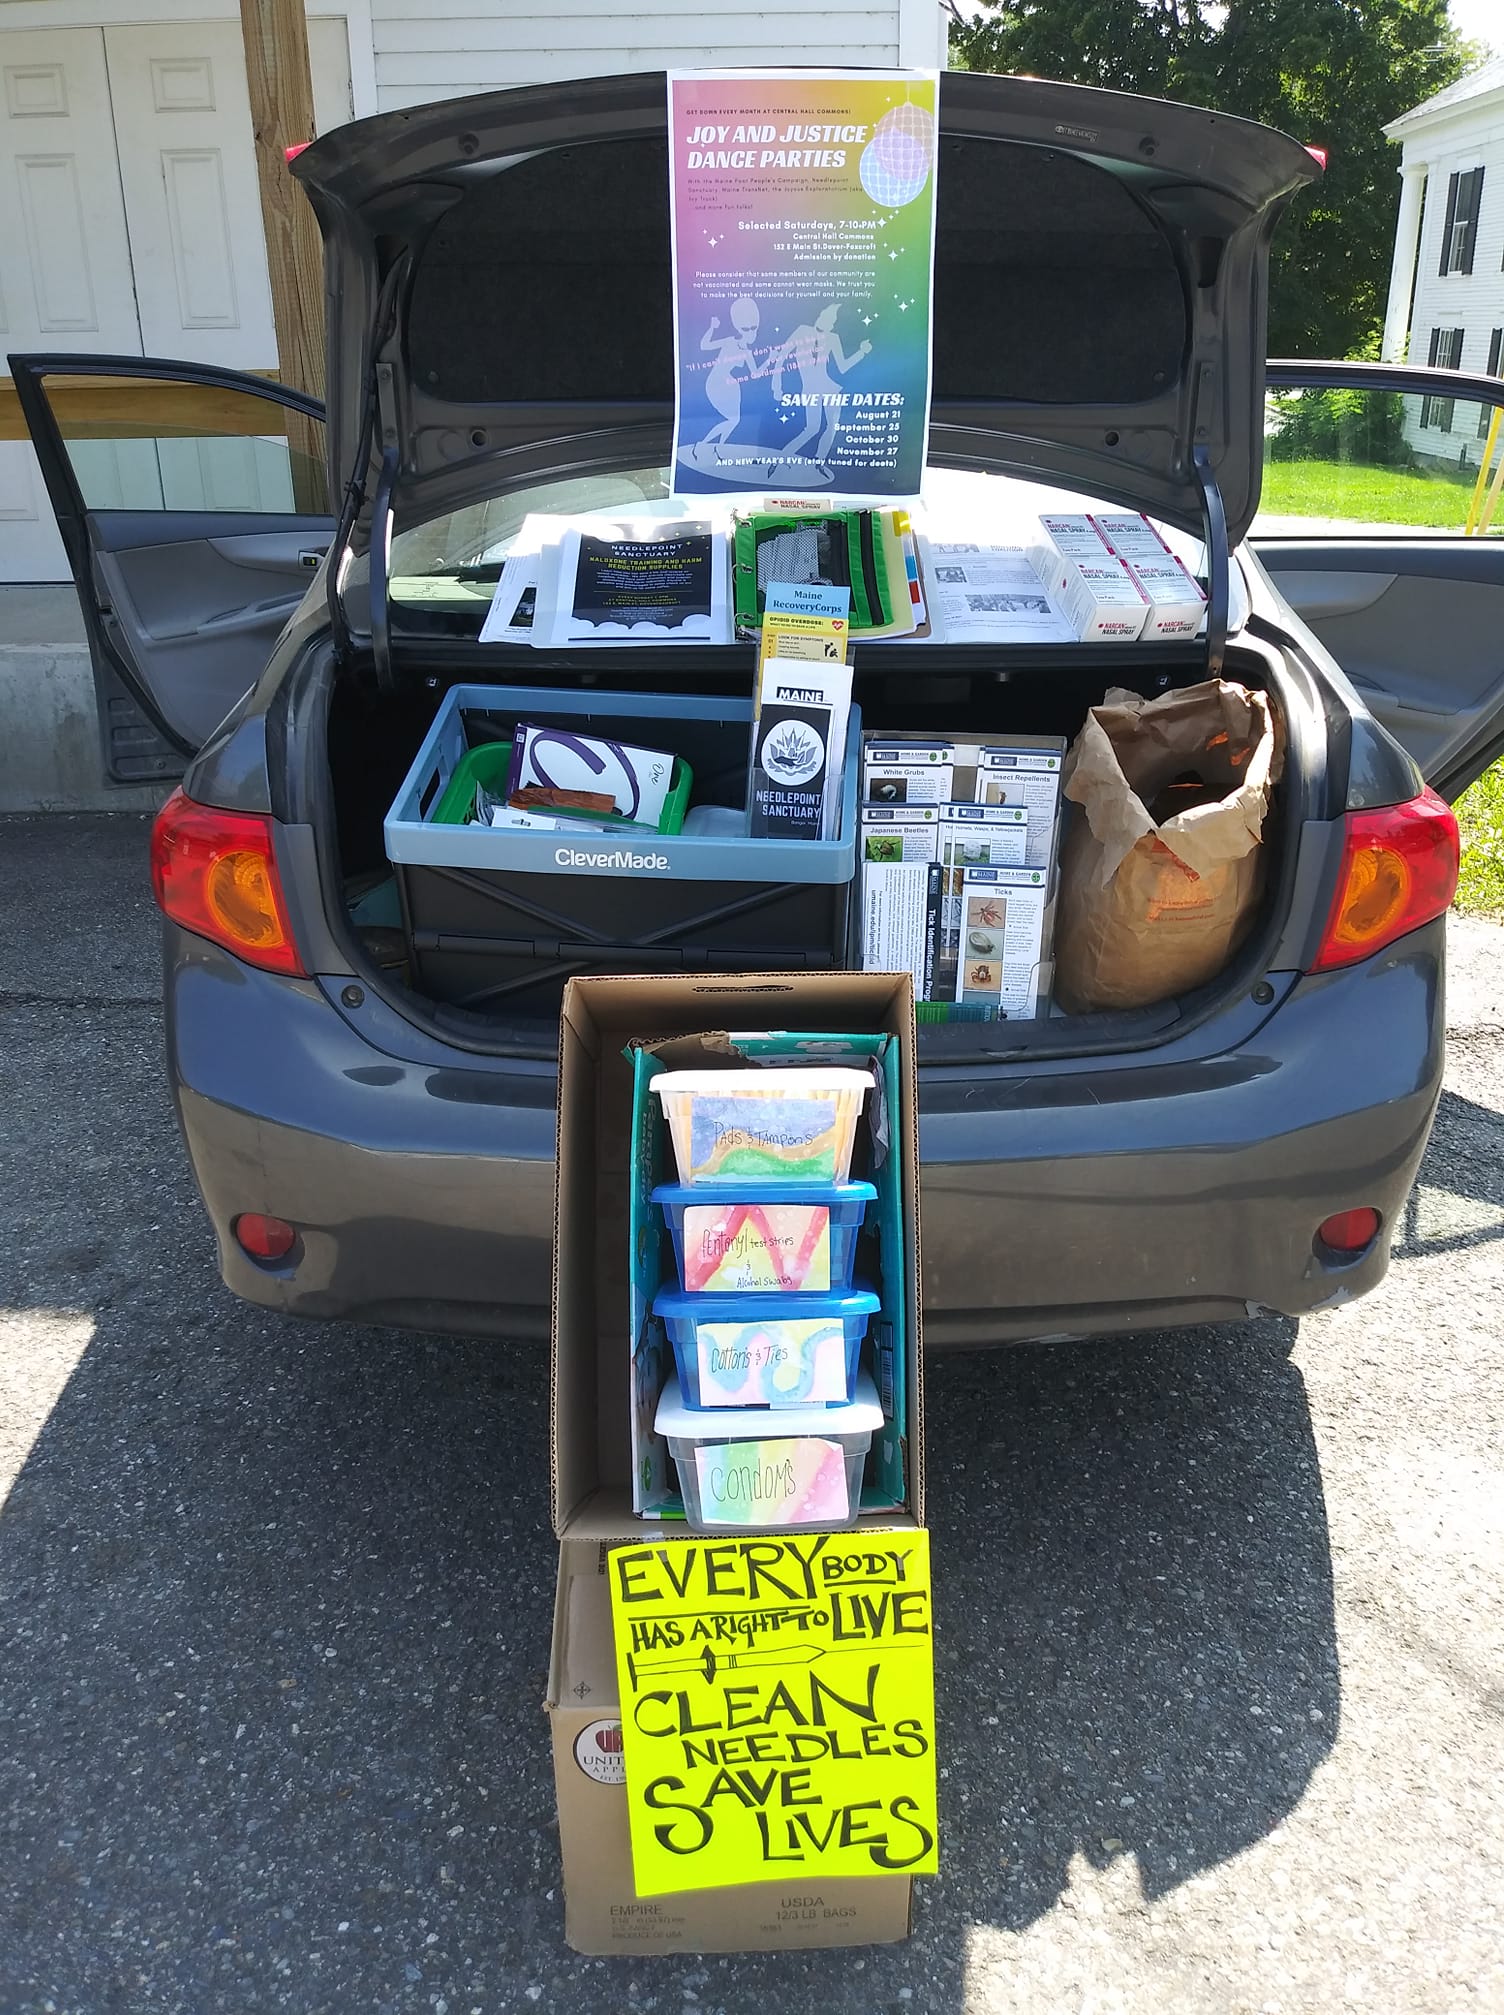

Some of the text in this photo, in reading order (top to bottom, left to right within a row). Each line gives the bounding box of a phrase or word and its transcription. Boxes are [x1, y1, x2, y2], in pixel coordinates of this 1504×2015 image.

[686, 125, 868, 144] JOY AND JUSTICE
[688, 150, 846, 169] DANCE PARTIES
[738, 221, 781, 230] Selected
[784, 221, 836, 231] Saturdays,
[781, 393, 905, 407] SAVE THE DATES:
[855, 411, 889, 420] August
[834, 424, 887, 433] September
[887, 435, 899, 443] 30
[837, 447, 898, 455] November 27
[828, 458, 852, 466] tuned
[794, 591, 822, 600] Maine
[773, 600, 842, 614] RecoveryCorps
[778, 688, 823, 702] MAINE
[756, 790, 821, 805] NEEDLEPOINT
[762, 805, 821, 818] SANCTUARY
[925, 928, 936, 979] Identification
[750, 1237, 767, 1248] test
[764, 1344, 788, 1366] Ties
[617, 1536, 830, 1603] EVERY
[822, 1548, 915, 1583] BODY
[630, 1619, 684, 1653] HAS
[711, 1610, 788, 1648] RIGHT
[830, 1591, 928, 1642] LIVE
[634, 1664, 880, 1737] CLEAN
[681, 1719, 929, 1769] NEEDLES
[644, 1768, 823, 1855] SAVE
[755, 1795, 933, 1869] LIVES
[781, 1897, 824, 1908] USDA
[610, 1904, 664, 1916] EMPIRE
[801, 1909, 816, 1919] LB
[823, 1906, 856, 1918] BAGS
